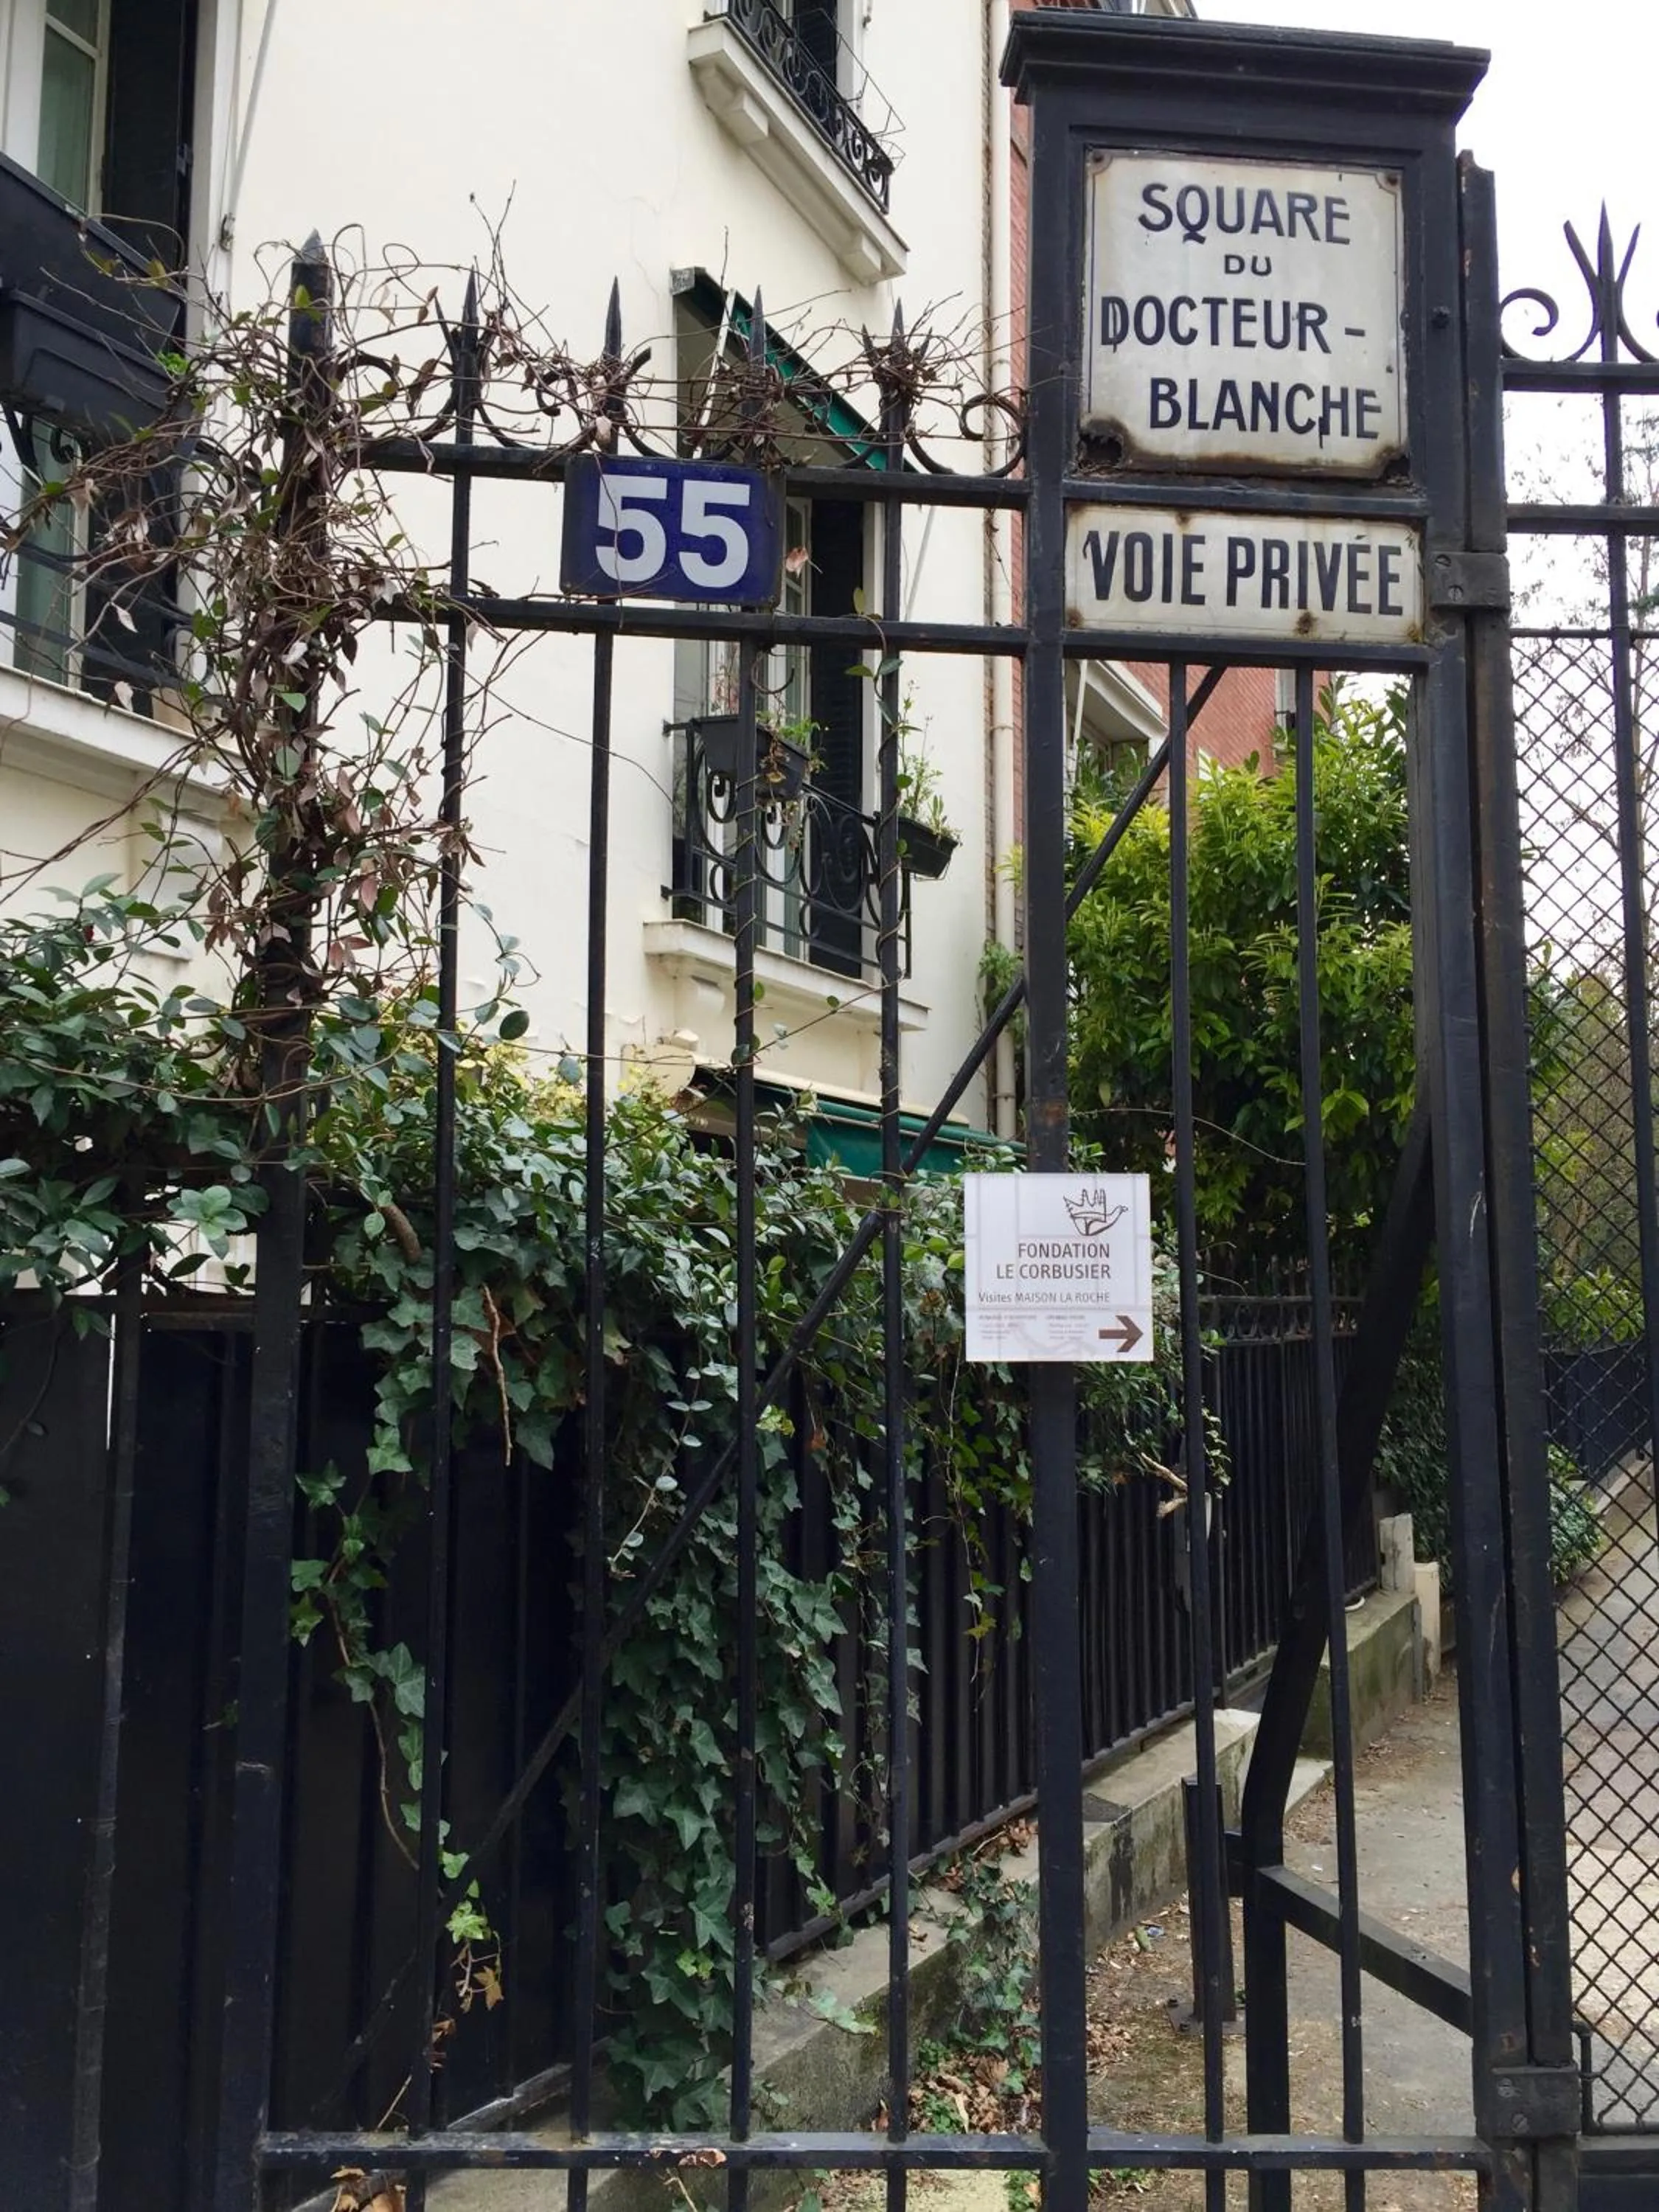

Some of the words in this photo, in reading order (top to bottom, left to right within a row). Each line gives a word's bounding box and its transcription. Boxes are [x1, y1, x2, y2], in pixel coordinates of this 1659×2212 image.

[1138, 183, 1351, 246] SQUARE
[1223, 254, 1273, 276] DU
[1150, 377, 1382, 440] BLANCHE
[595, 473, 751, 588] 55
[1084, 529, 1206, 607] VOIE
[1226, 534, 1403, 616] PRIVÉE
[995, 1263, 1014, 1279] LE
[1019, 1263, 1112, 1280] CORBUSIER
[1018, 1242, 1110, 1259] FONDATION
[978, 1291, 1012, 1304] Visites
[1015, 1291, 1057, 1304] MAISON
[1060, 1291, 1073, 1304] LA
[1075, 1291, 1110, 1304] ROCHE
